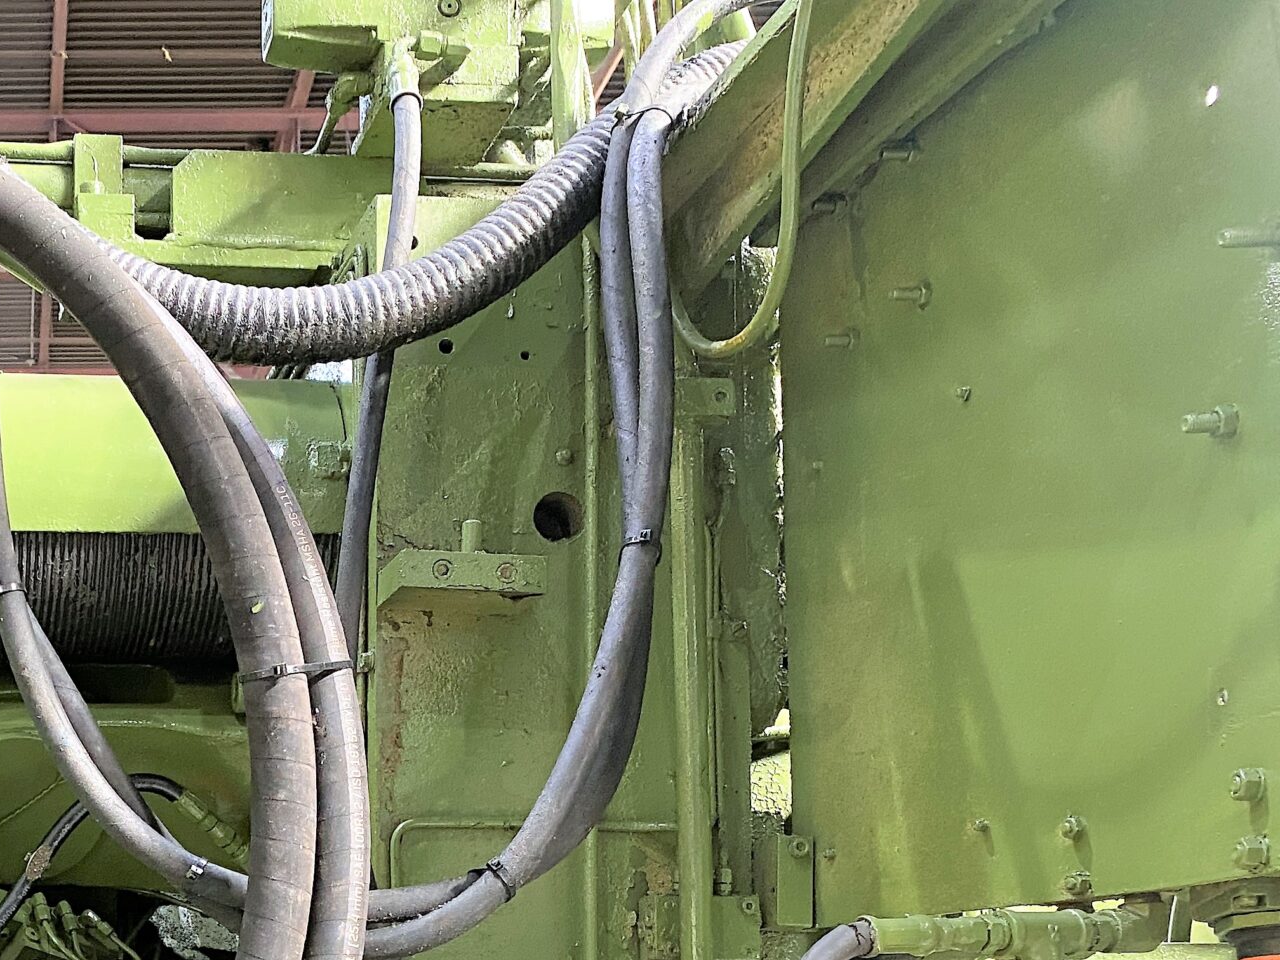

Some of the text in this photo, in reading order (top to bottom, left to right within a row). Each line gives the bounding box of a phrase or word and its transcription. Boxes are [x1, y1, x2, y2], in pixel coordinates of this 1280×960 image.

[274, 483, 302, 528] 2G-11C
[293, 528, 315, 562] MSHA
[354, 853, 364, 876] SAE
